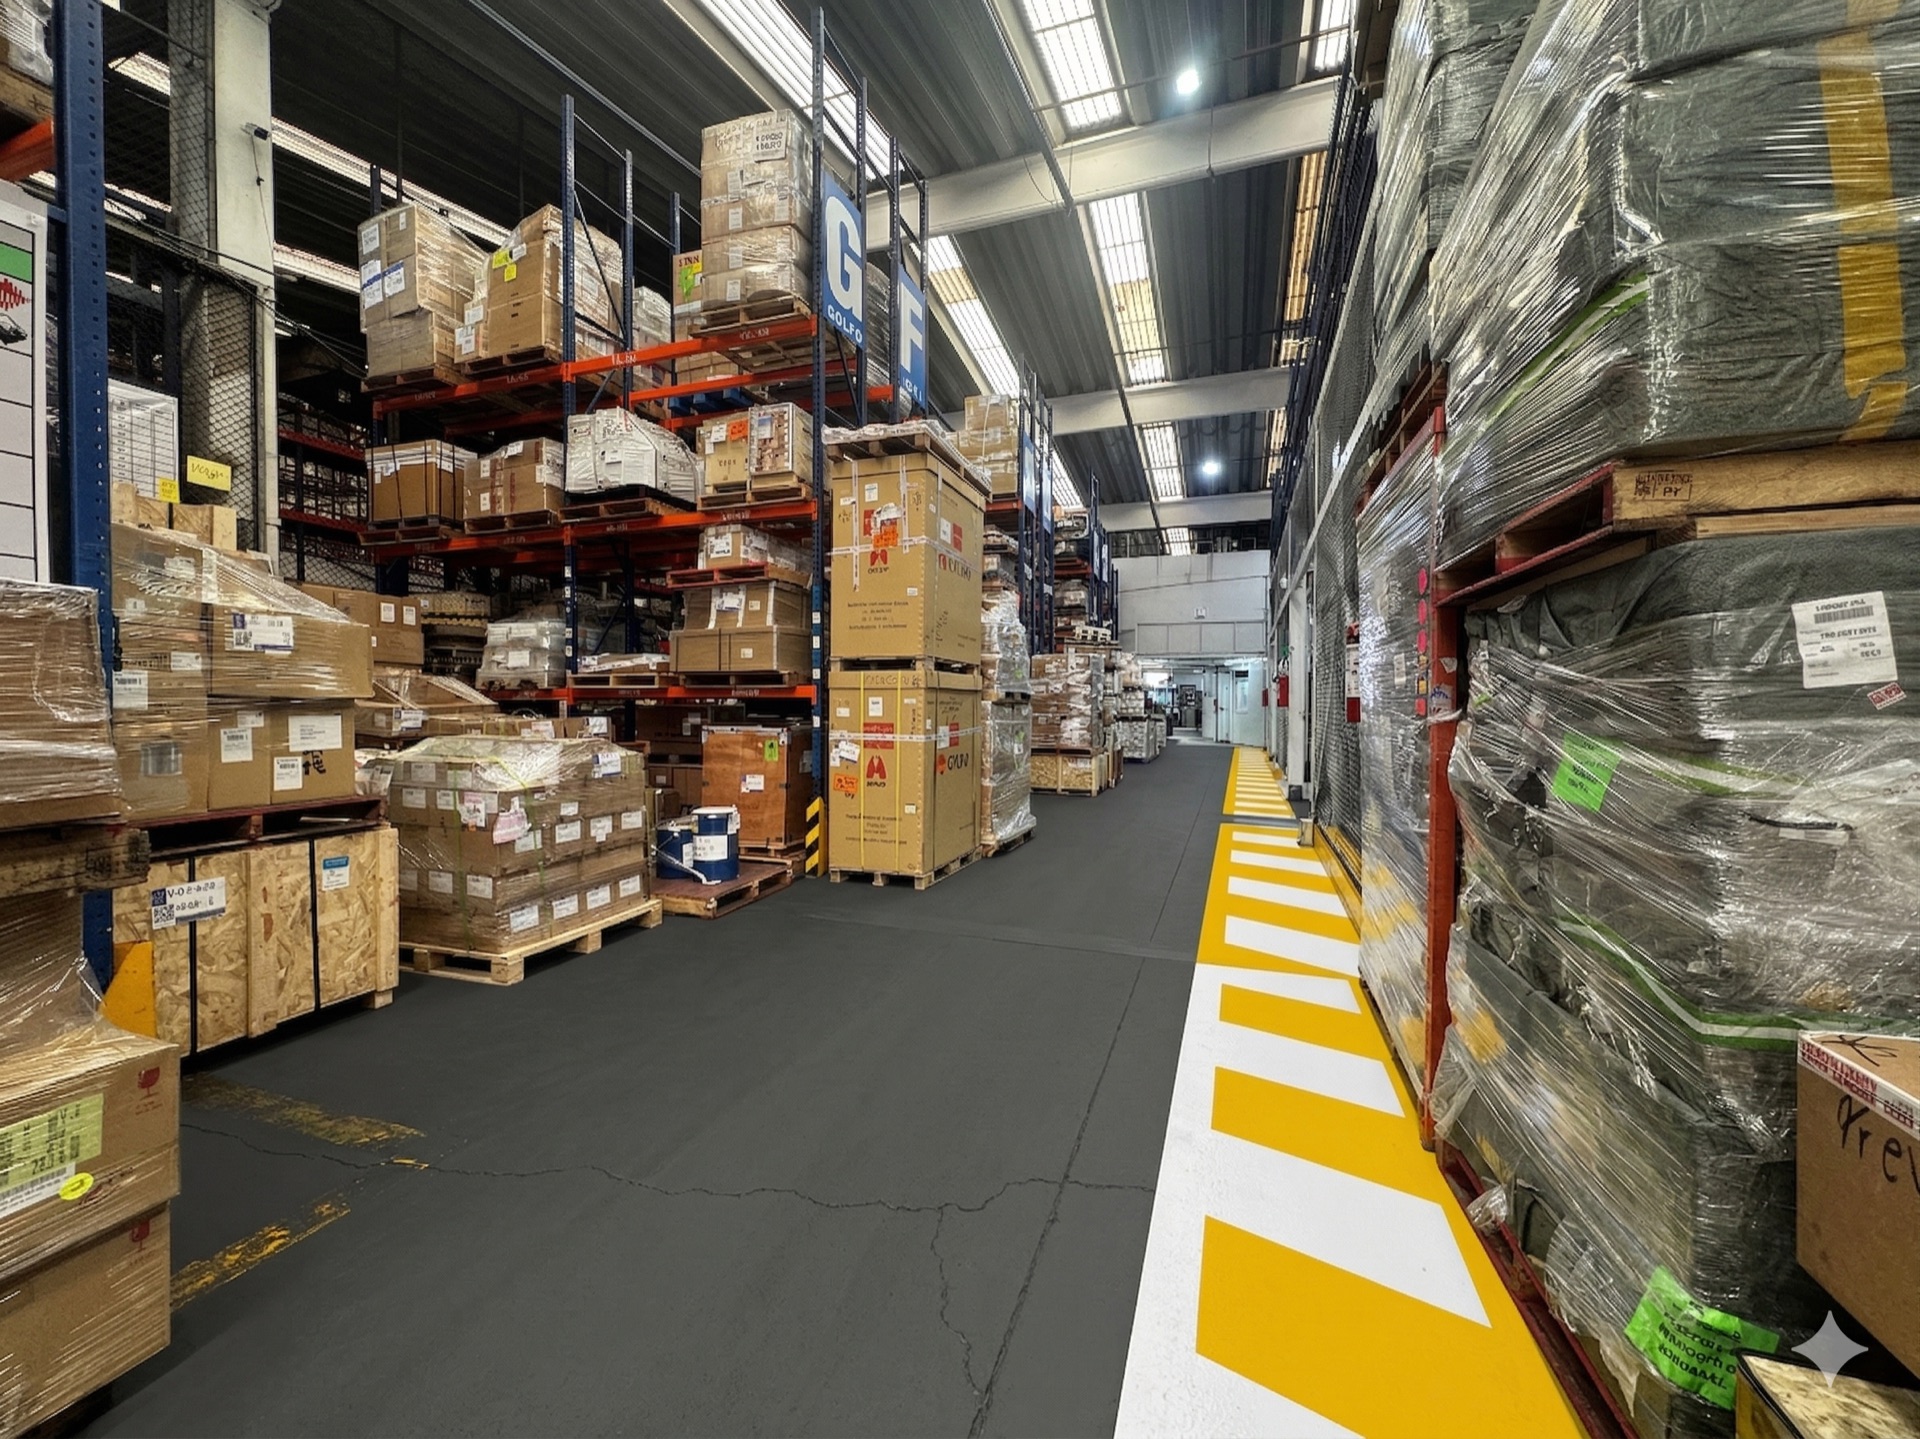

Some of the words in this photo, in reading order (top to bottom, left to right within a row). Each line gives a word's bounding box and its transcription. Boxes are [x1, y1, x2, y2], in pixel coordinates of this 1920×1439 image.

[825, 196, 862, 322] G
[827, 304, 863, 344] GOLFO
[900, 281, 923, 373] F
